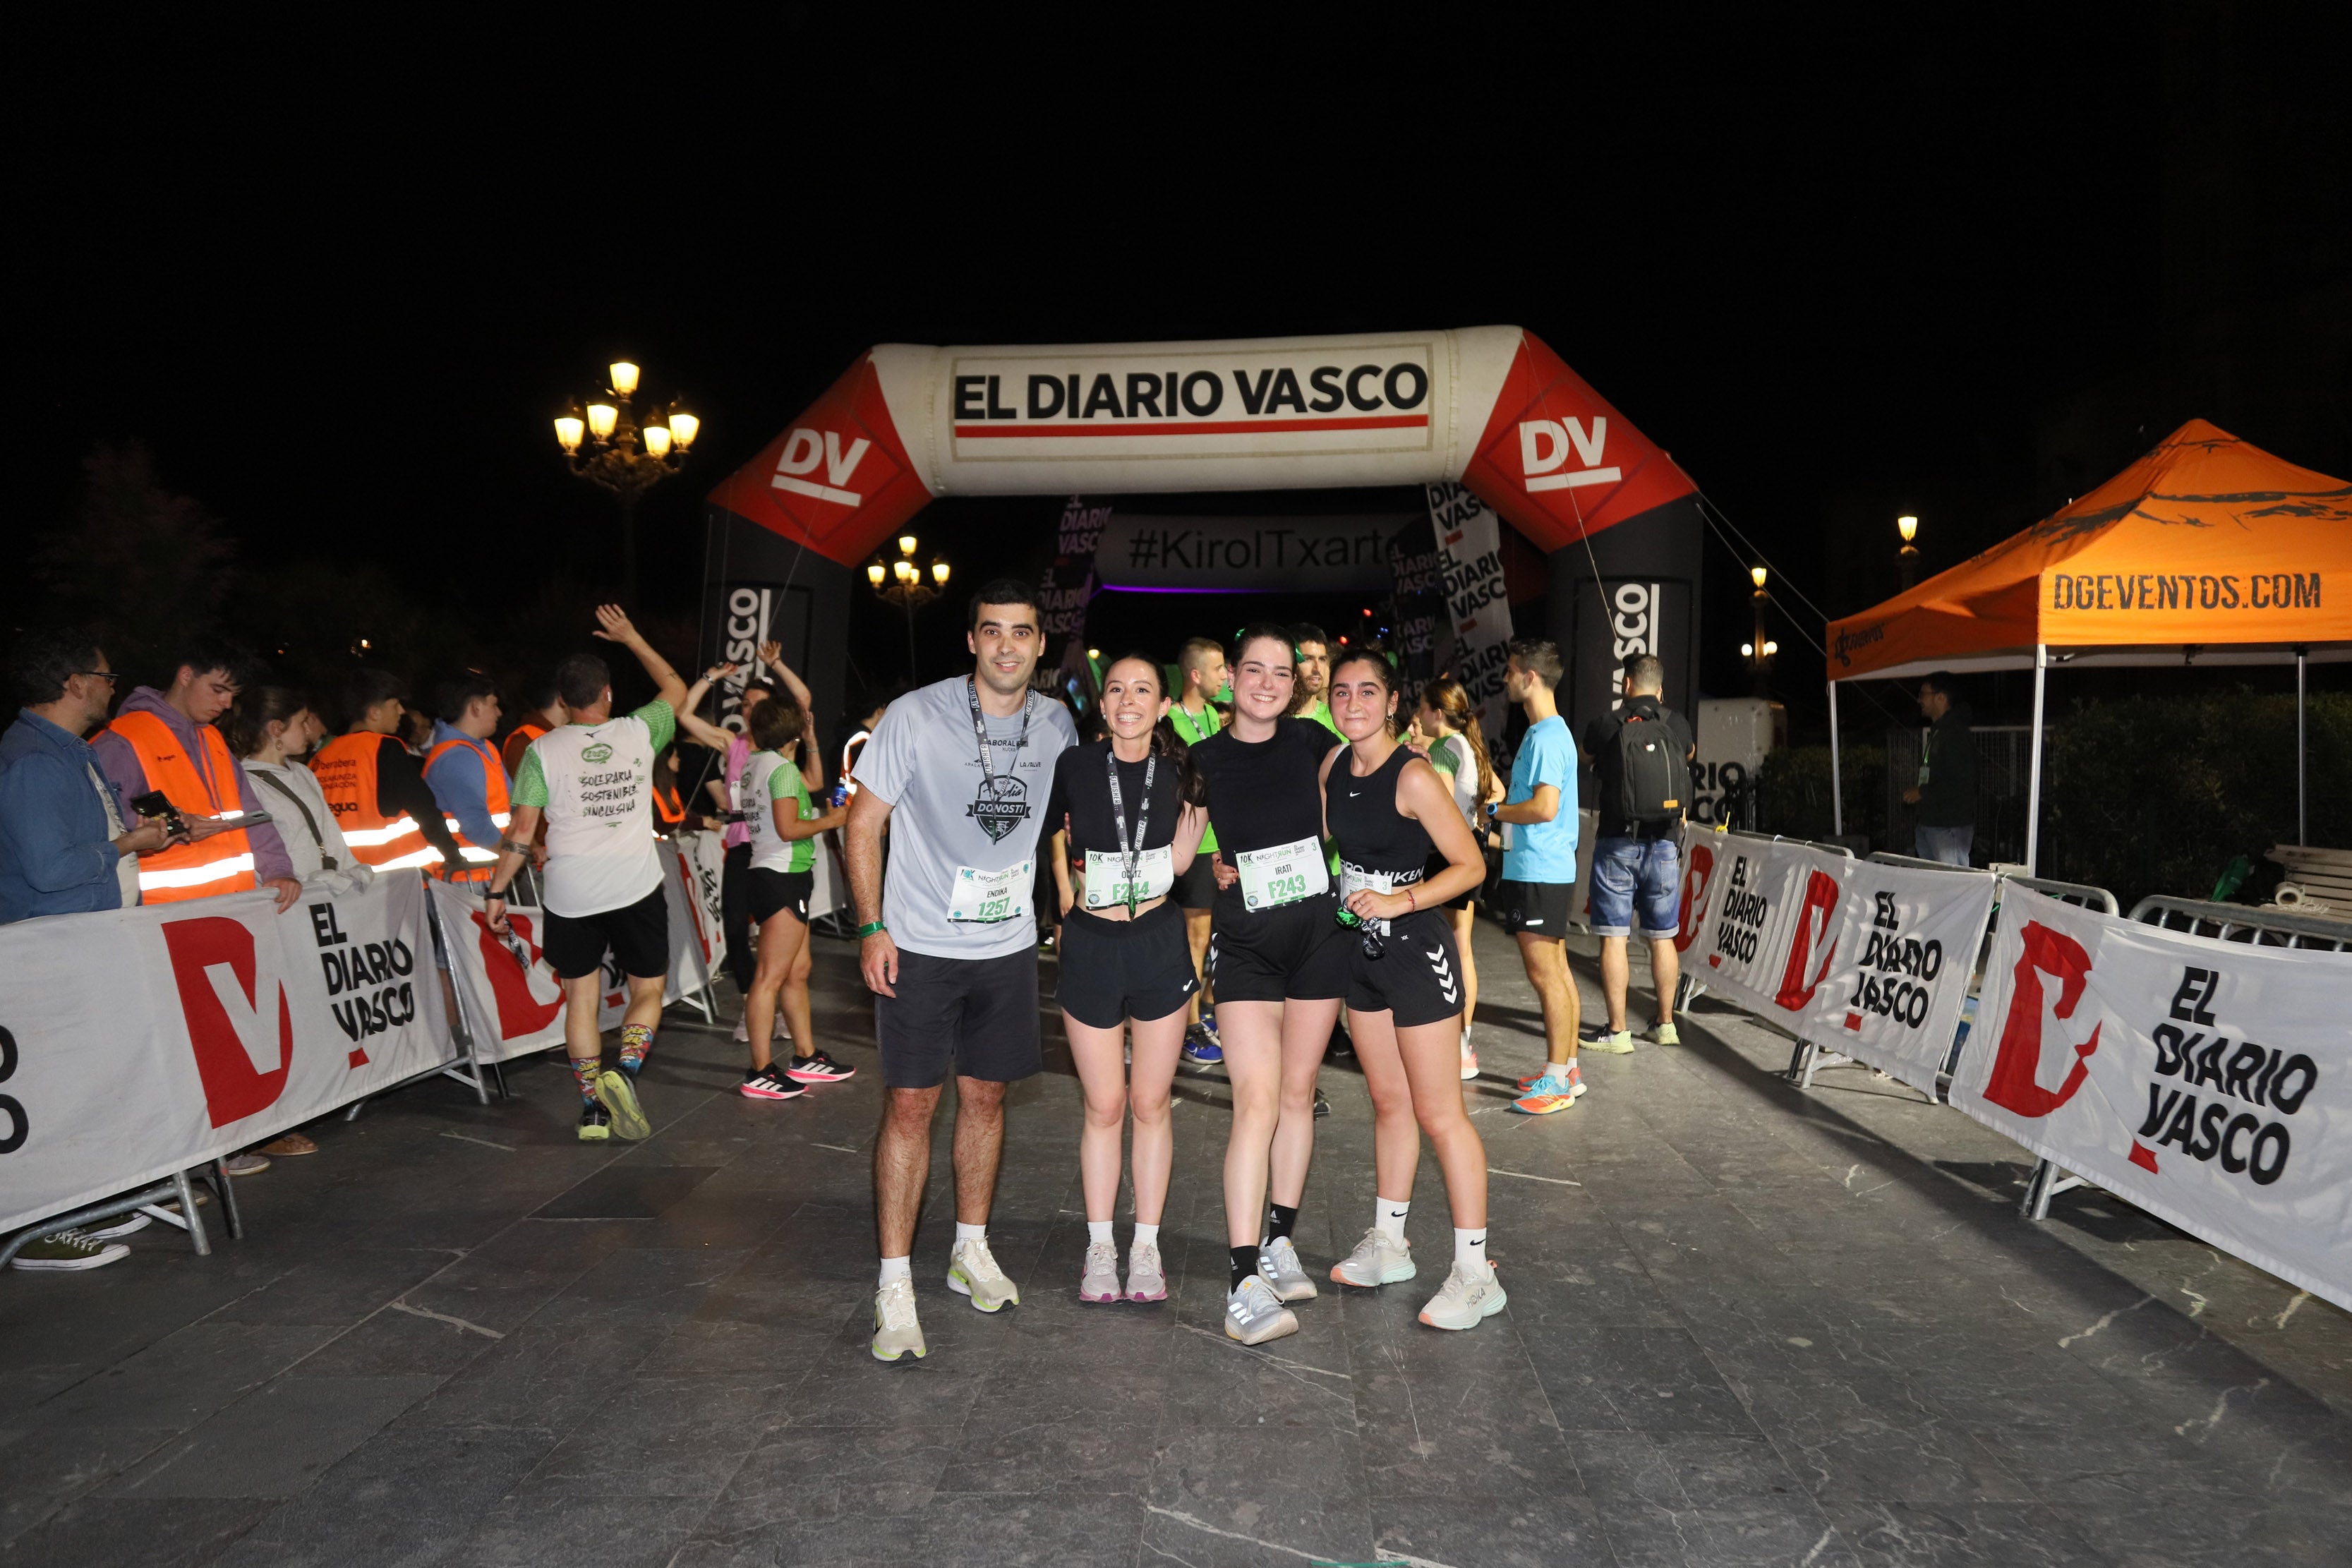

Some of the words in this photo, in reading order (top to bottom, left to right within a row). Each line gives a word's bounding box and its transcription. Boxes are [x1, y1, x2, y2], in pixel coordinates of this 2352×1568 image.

[955, 375, 1016, 419] EL
[1027, 371, 1223, 419] DIARIO
[1234, 362, 1428, 415] VASCO
[776, 428, 871, 487] DV
[1519, 416, 1607, 476] DV
[1059, 533, 1099, 555] VASC
[1445, 551, 1500, 598] DIARI
[1451, 577, 1507, 619] VASC
[2054, 572, 2321, 610] DGEVENTOS.COM
[980, 744, 992, 774] FINISHER
[1145, 756, 1155, 787] FINISHER
[580, 769, 632, 788] SOLIDARIA
[581, 783, 637, 802] SOSTENIBLE
[1109, 776, 1121, 804] FINISHER
[977, 803, 1024, 814] DONOSTI
[1135, 820, 1146, 850] FINISHER
[1089, 853, 1104, 863] 10K
[1162, 850, 1168, 859] 3
[1240, 853, 1255, 864] 10K
[1311, 842, 1317, 851] 3
[1274, 864, 1292, 875] IRATI
[1731, 856, 1747, 886] EL
[987, 886, 1008, 898] ENDIKA
[1112, 881, 1150, 900] F244
[1267, 875, 1306, 899] F243
[1382, 881, 1387, 891] 3
[978, 896, 1011, 916] 1257
[1723, 888, 1767, 929] DIARIO
[1874, 891, 1899, 931] EL
[308, 903, 347, 947] EL
[1718, 922, 1758, 965] VASCO
[321, 939, 413, 996] DIARIO
[2169, 965, 2219, 1027] EL
[332, 982, 414, 1042] VASCO
[2152, 1023, 2318, 1115] DIARIO
[2137, 1083, 2290, 1186] VASCO
[1464, 1287, 1486, 1310] HOKA
